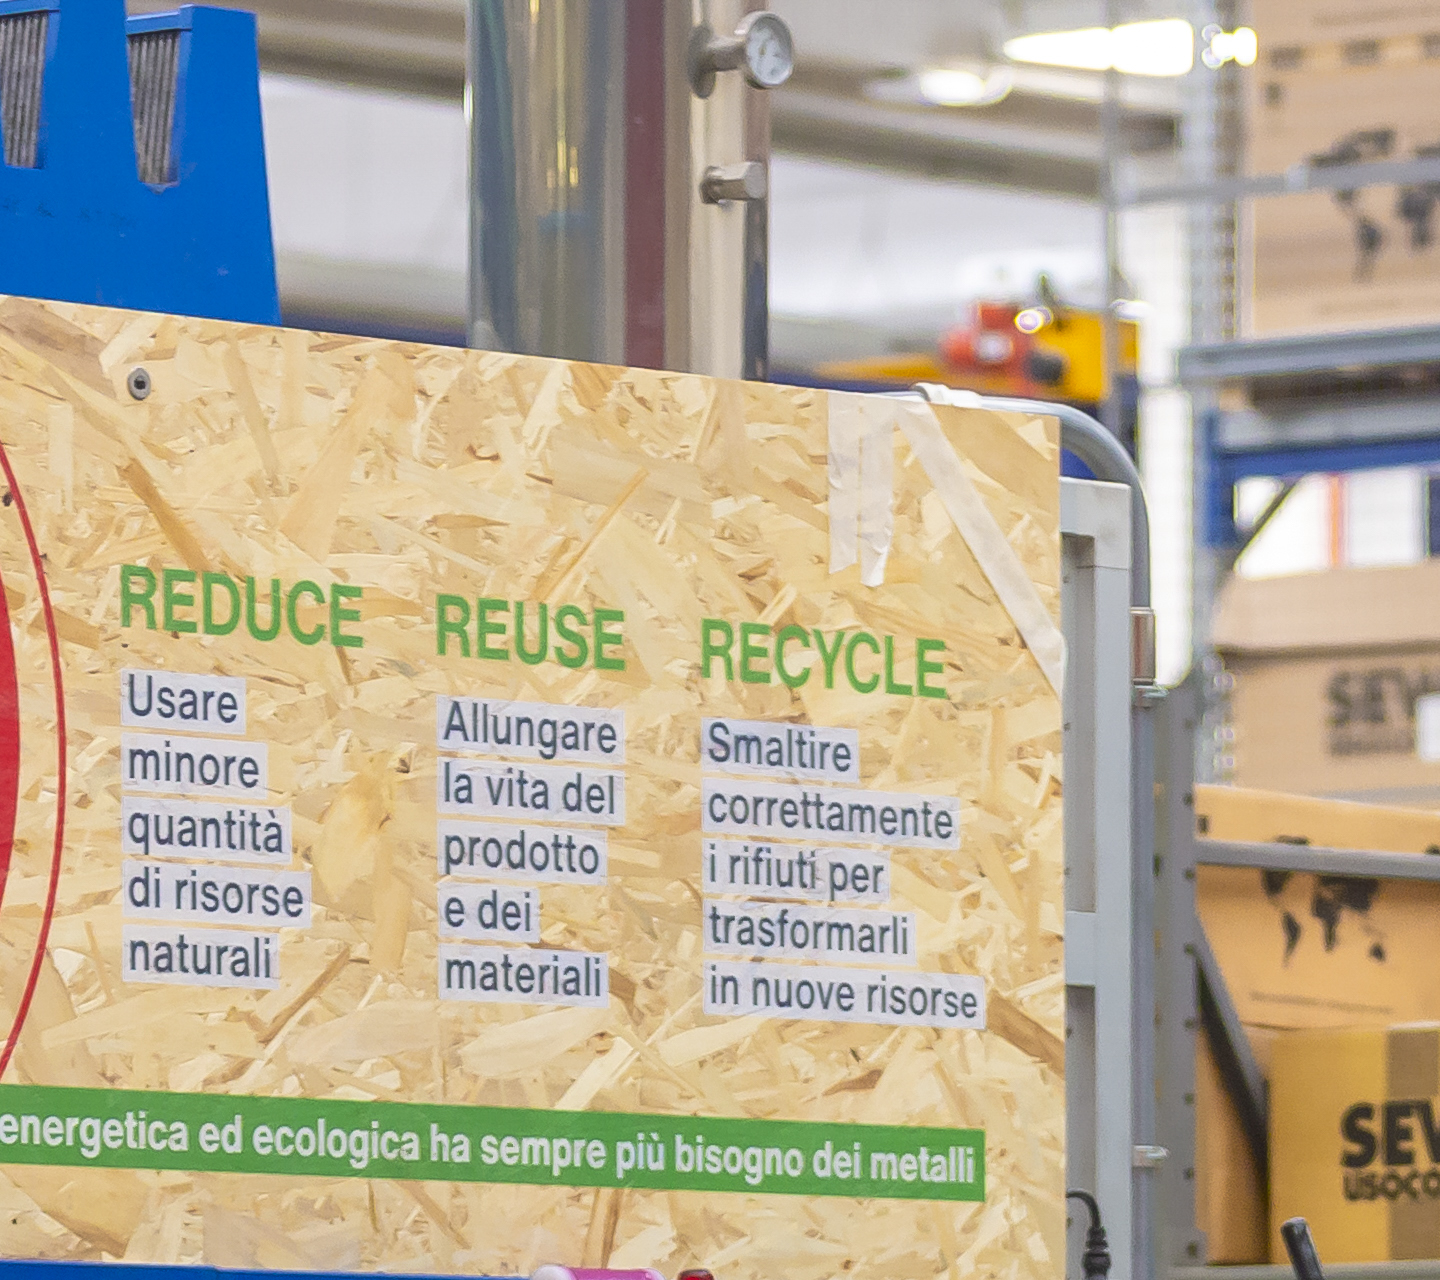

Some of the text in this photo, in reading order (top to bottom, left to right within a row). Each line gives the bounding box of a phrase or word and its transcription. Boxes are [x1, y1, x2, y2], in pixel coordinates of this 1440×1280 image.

[120, 564, 364, 648] REDUCE
[437, 593, 626, 671] REUSE
[701, 617, 948, 699] RECYCLE
[128, 674, 239, 723] Usare
[444, 701, 617, 760] Allungare
[708, 721, 852, 772] Smaltire
[129, 740, 260, 788] minore
[444, 762, 616, 815] la vita del
[129, 809, 283, 855] quantità
[708, 791, 953, 840] correttamente
[444, 830, 599, 875] prodotto
[709, 843, 885, 901] i rifiuti per
[129, 867, 304, 918] di risorse
[444, 890, 532, 932] e dei
[709, 905, 909, 955] trasformarli
[129, 934, 272, 979] naturali
[445, 955, 602, 997] materiali
[710, 964, 978, 1020] in nuove risorse
[198, 1114, 243, 1155] ed
[252, 1118, 420, 1169] ecologica
[430, 1123, 470, 1163] ha
[480, 1134, 607, 1175] sempre
[616, 1132, 666, 1178] più
[675, 1134, 805, 1185] bisogno
[812, 1140, 861, 1180] dei
[870, 1145, 975, 1184] metalli
